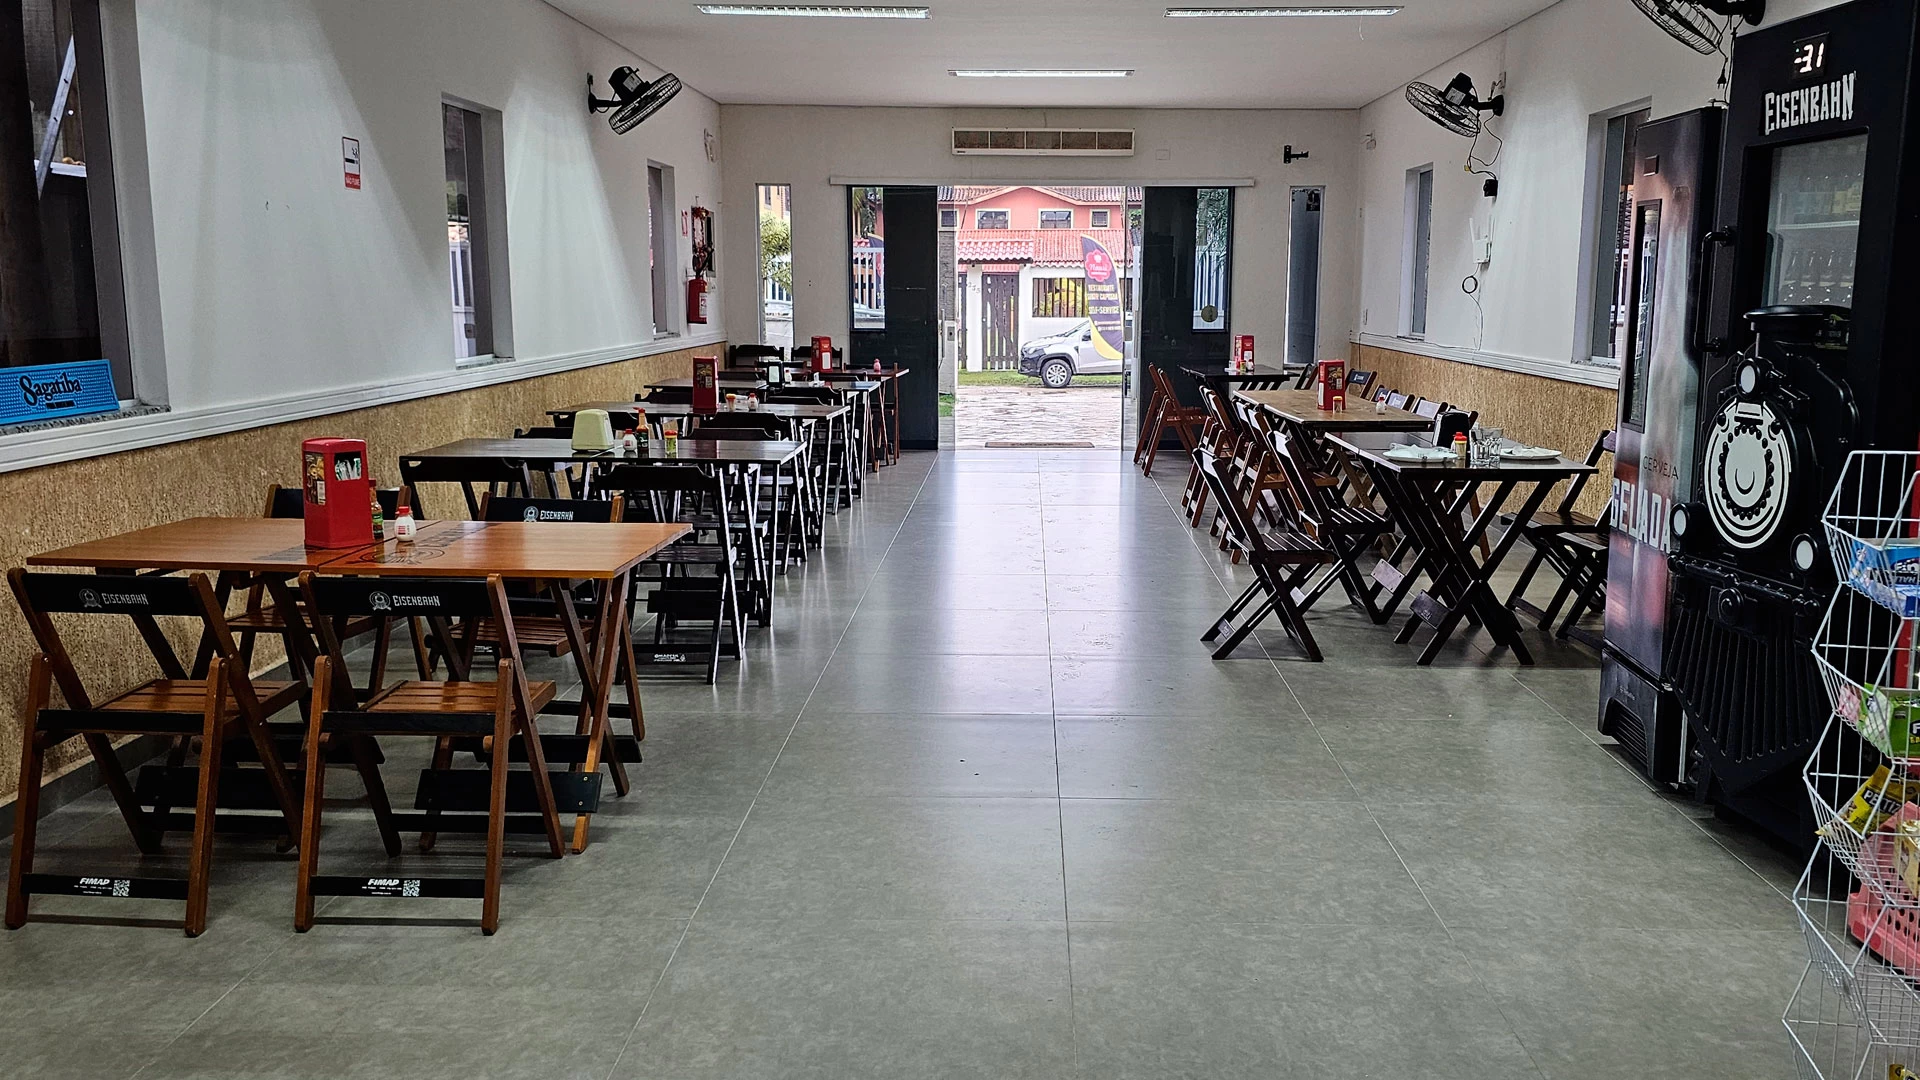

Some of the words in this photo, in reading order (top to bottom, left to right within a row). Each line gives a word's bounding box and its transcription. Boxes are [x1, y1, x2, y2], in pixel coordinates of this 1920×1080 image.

[1764, 73, 1854, 136] EISENBAHN
[19, 372, 83, 407] Sagatiba
[1643, 456, 1679, 480] CERVEJA
[540, 510, 574, 521] EISENBAHN
[1610, 477, 1671, 554] GELADA
[101, 592, 149, 606] EISENBAHN
[392, 595, 441, 607] EISENBAHN
